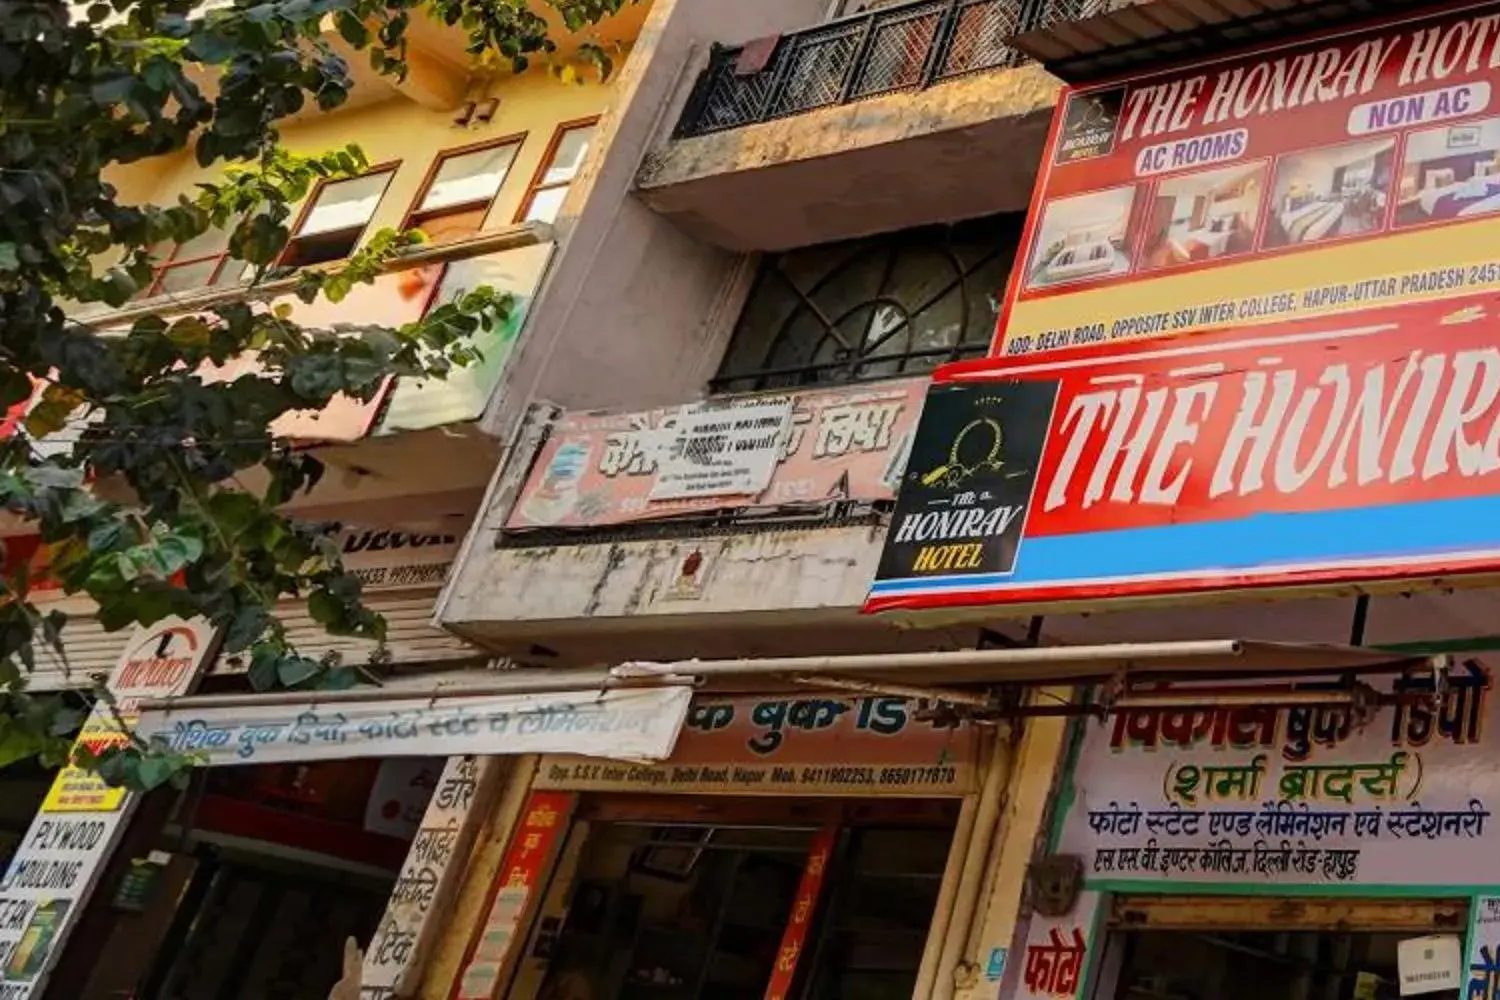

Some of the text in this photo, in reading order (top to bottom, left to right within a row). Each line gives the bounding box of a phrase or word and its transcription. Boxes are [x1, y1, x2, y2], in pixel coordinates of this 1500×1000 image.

[1120, 77, 1205, 142] THE
[1202, 35, 1400, 125] HONIRAV
[1367, 87, 1472, 129] NON AC
[1140, 131, 1244, 172] AC ROOMS
[1036, 328, 1070, 350] DELHI
[1111, 316, 1169, 339] OPPOSITE
[1172, 309, 1197, 331] SSV
[1199, 302, 1236, 325] INTER
[1400, 268, 1464, 294] PRADESH
[1042, 378, 1213, 512] THE
[894, 505, 1023, 543] HONIRAV
[912, 543, 984, 571] HOTEL
[30, 821, 105, 850] PLYWOOD
[1088, 802, 1142, 836] फोटो
[1146, 802, 1204, 836] स्टेट
[1025, 928, 1086, 995] फोटो
